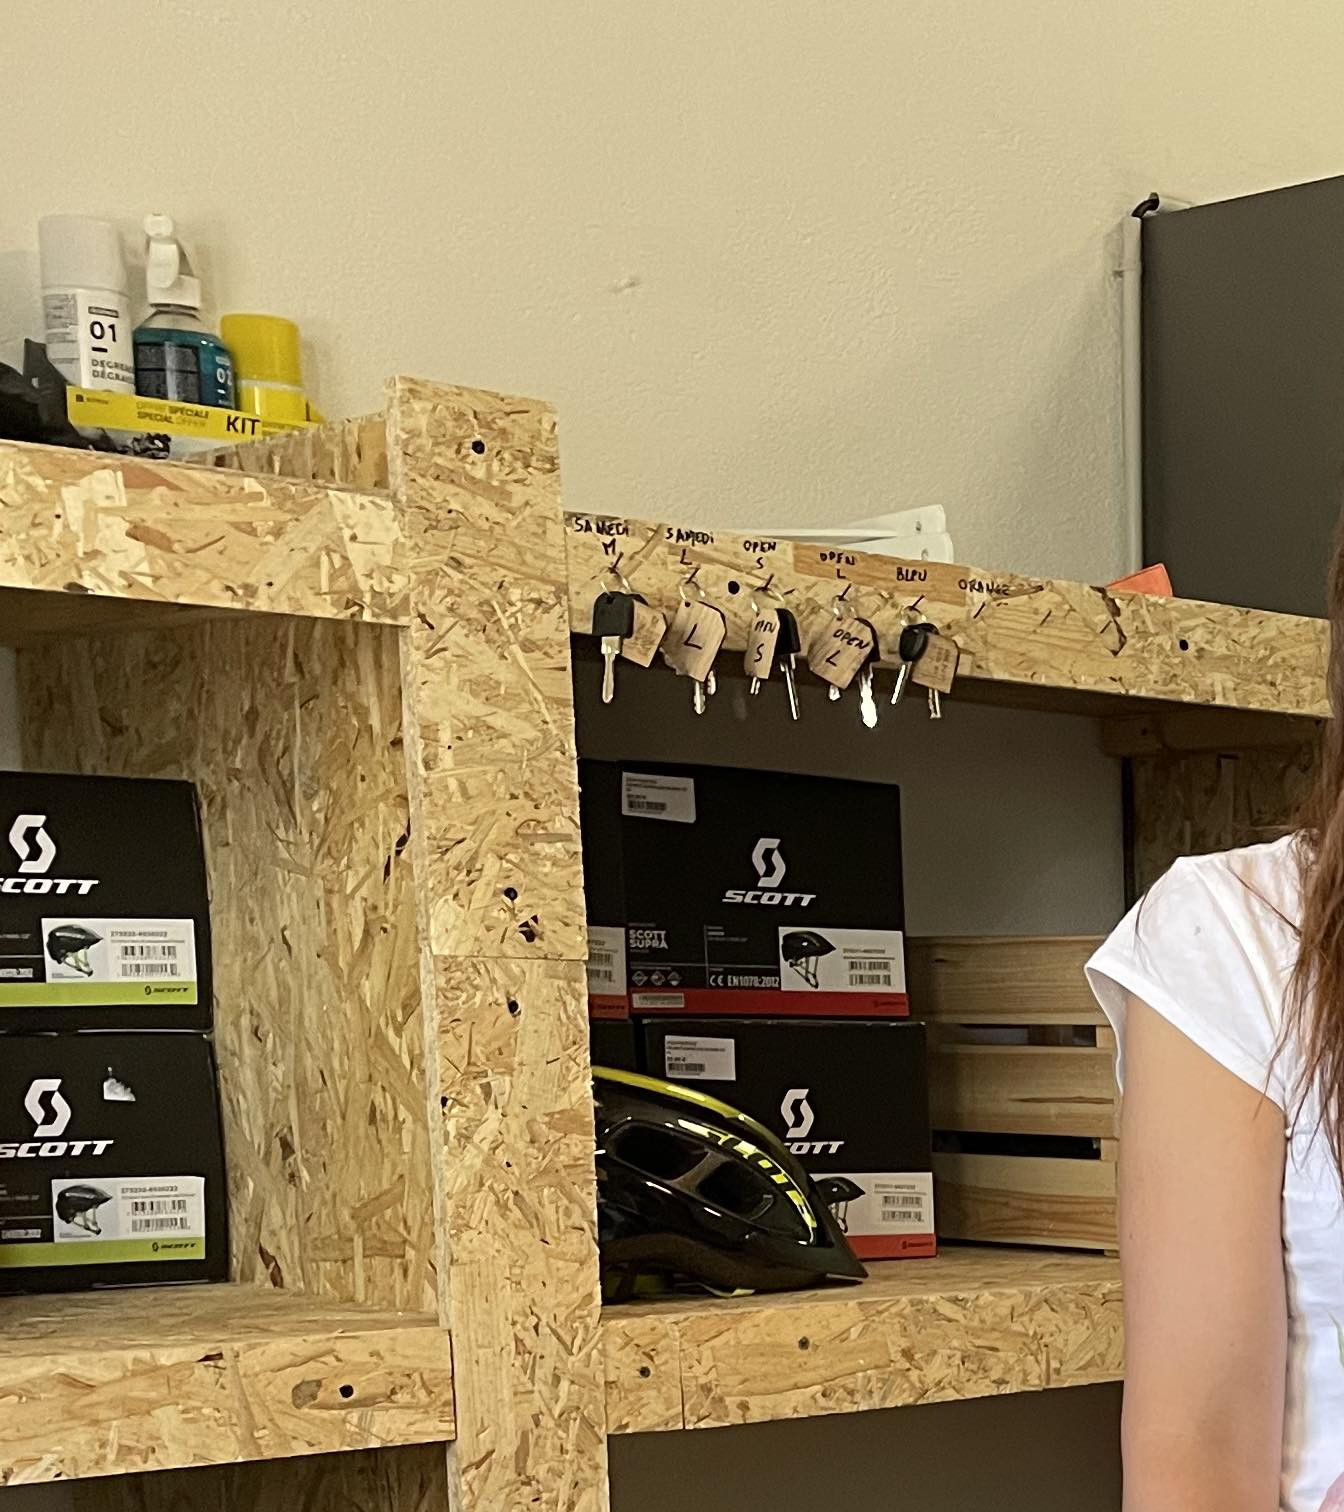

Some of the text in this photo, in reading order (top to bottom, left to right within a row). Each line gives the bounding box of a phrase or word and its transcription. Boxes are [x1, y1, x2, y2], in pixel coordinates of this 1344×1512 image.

[90, 321, 117, 343] 01
[226, 415, 260, 435] KIT
[602, 538, 617, 555] M
[743, 540, 776, 553] OPEN
[680, 549, 692, 565] L
[756, 557, 764, 569] S
[819, 551, 856, 566] OPEN
[837, 569, 846, 580] L
[833, 629, 870, 650] OPEN
[0, 877, 100, 895] COTT
[722, 889, 817, 907] SCOTT
[629, 929, 666, 939] SCOTT
[629, 939, 669, 950] SUPRA
[0, 1139, 114, 1158] SCOTT
[784, 1140, 844, 1155] OTT
